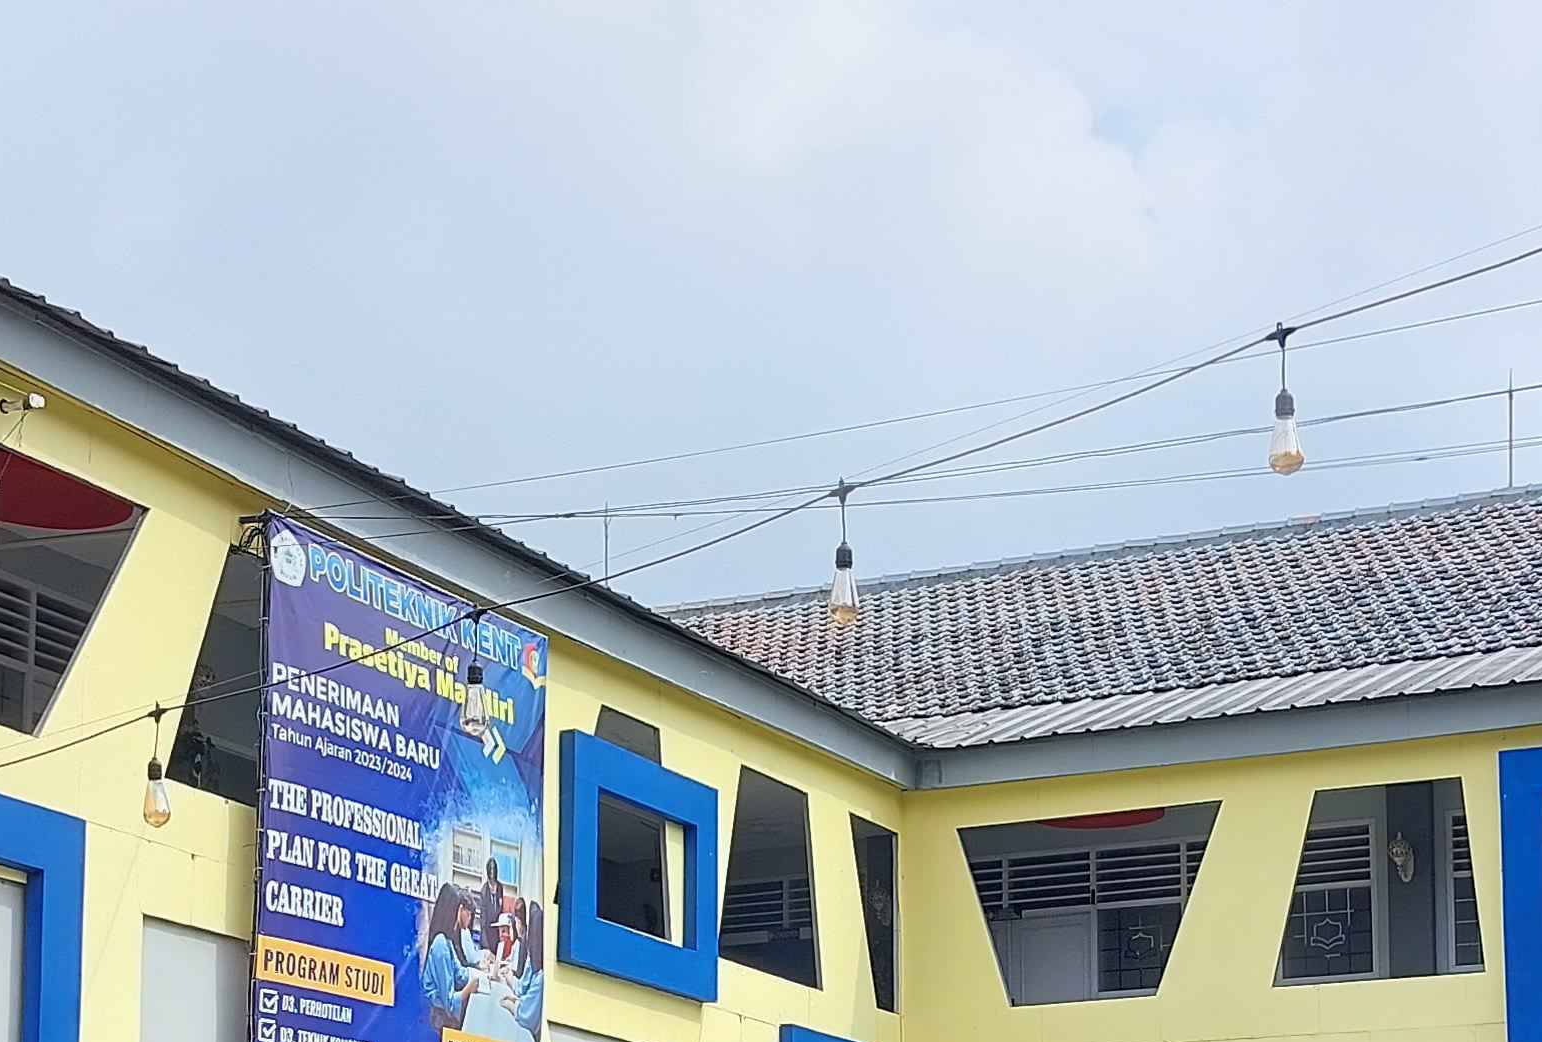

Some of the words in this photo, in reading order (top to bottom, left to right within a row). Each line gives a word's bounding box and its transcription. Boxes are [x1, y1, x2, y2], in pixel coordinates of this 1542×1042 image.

[309, 543, 458, 644] POLITEKNIK
[461, 611, 521, 670] KENT
[324, 621, 430, 691] Prasetiya
[385, 627, 442, 665] Member
[445, 655, 459, 674] of
[272, 662, 399, 728] PENERIMAAN
[271, 723, 312, 748] Tahun
[315, 736, 352, 761] Ajaran
[353, 749, 412, 782] 2023/2024
[272, 692, 392, 753] MAHASISWA
[395, 733, 440, 770] BARU
[268, 778, 308, 816] THE
[310, 789, 425, 850] PROFESSIONAL
[266, 830, 315, 868] PLAN
[317, 841, 352, 879] FOR
[355, 853, 387, 889] THE
[390, 861, 438, 904] GREAT
[265, 880, 345, 928] CARRIER
[263, 949, 340, 987] PROGRAM
[345, 966, 385, 996] STUDI
[300, 998, 353, 1024] PERHOTELAN
